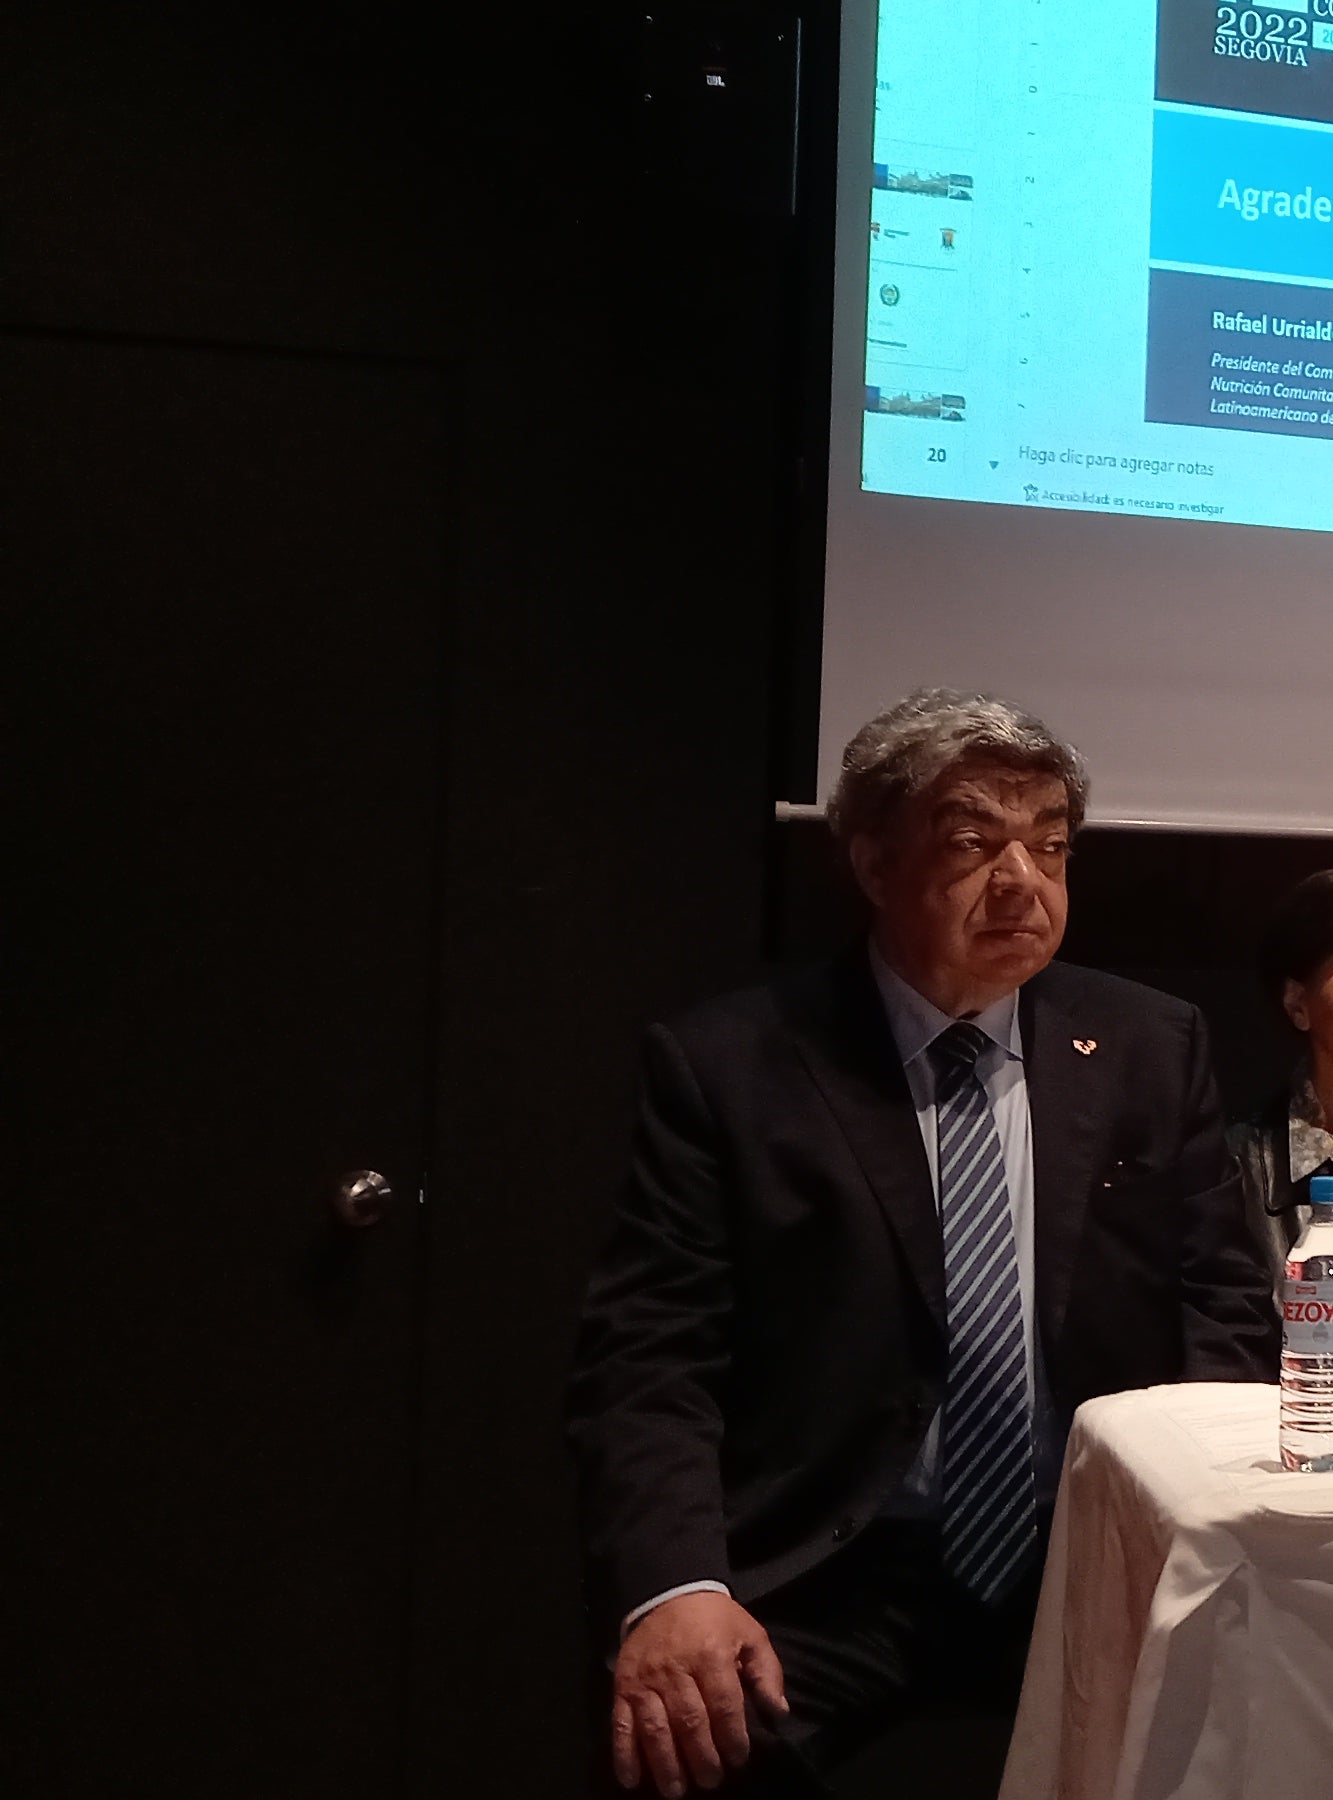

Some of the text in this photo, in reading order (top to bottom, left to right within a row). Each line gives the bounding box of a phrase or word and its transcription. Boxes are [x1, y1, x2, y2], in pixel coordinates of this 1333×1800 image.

[1216, 7, 1308, 46] 2022
[1213, 35, 1308, 67] SEGOVIA
[1212, 311, 1267, 335] Rafael
[1211, 352, 1280, 374] Presidente
[1282, 360, 1302, 376] del
[1210, 377, 1271, 397] Nutrición
[1210, 399, 1318, 423] Latinoamericano
[927, 448, 947, 462] 20
[1018, 446, 1215, 476] Haga clic para agregar notas
